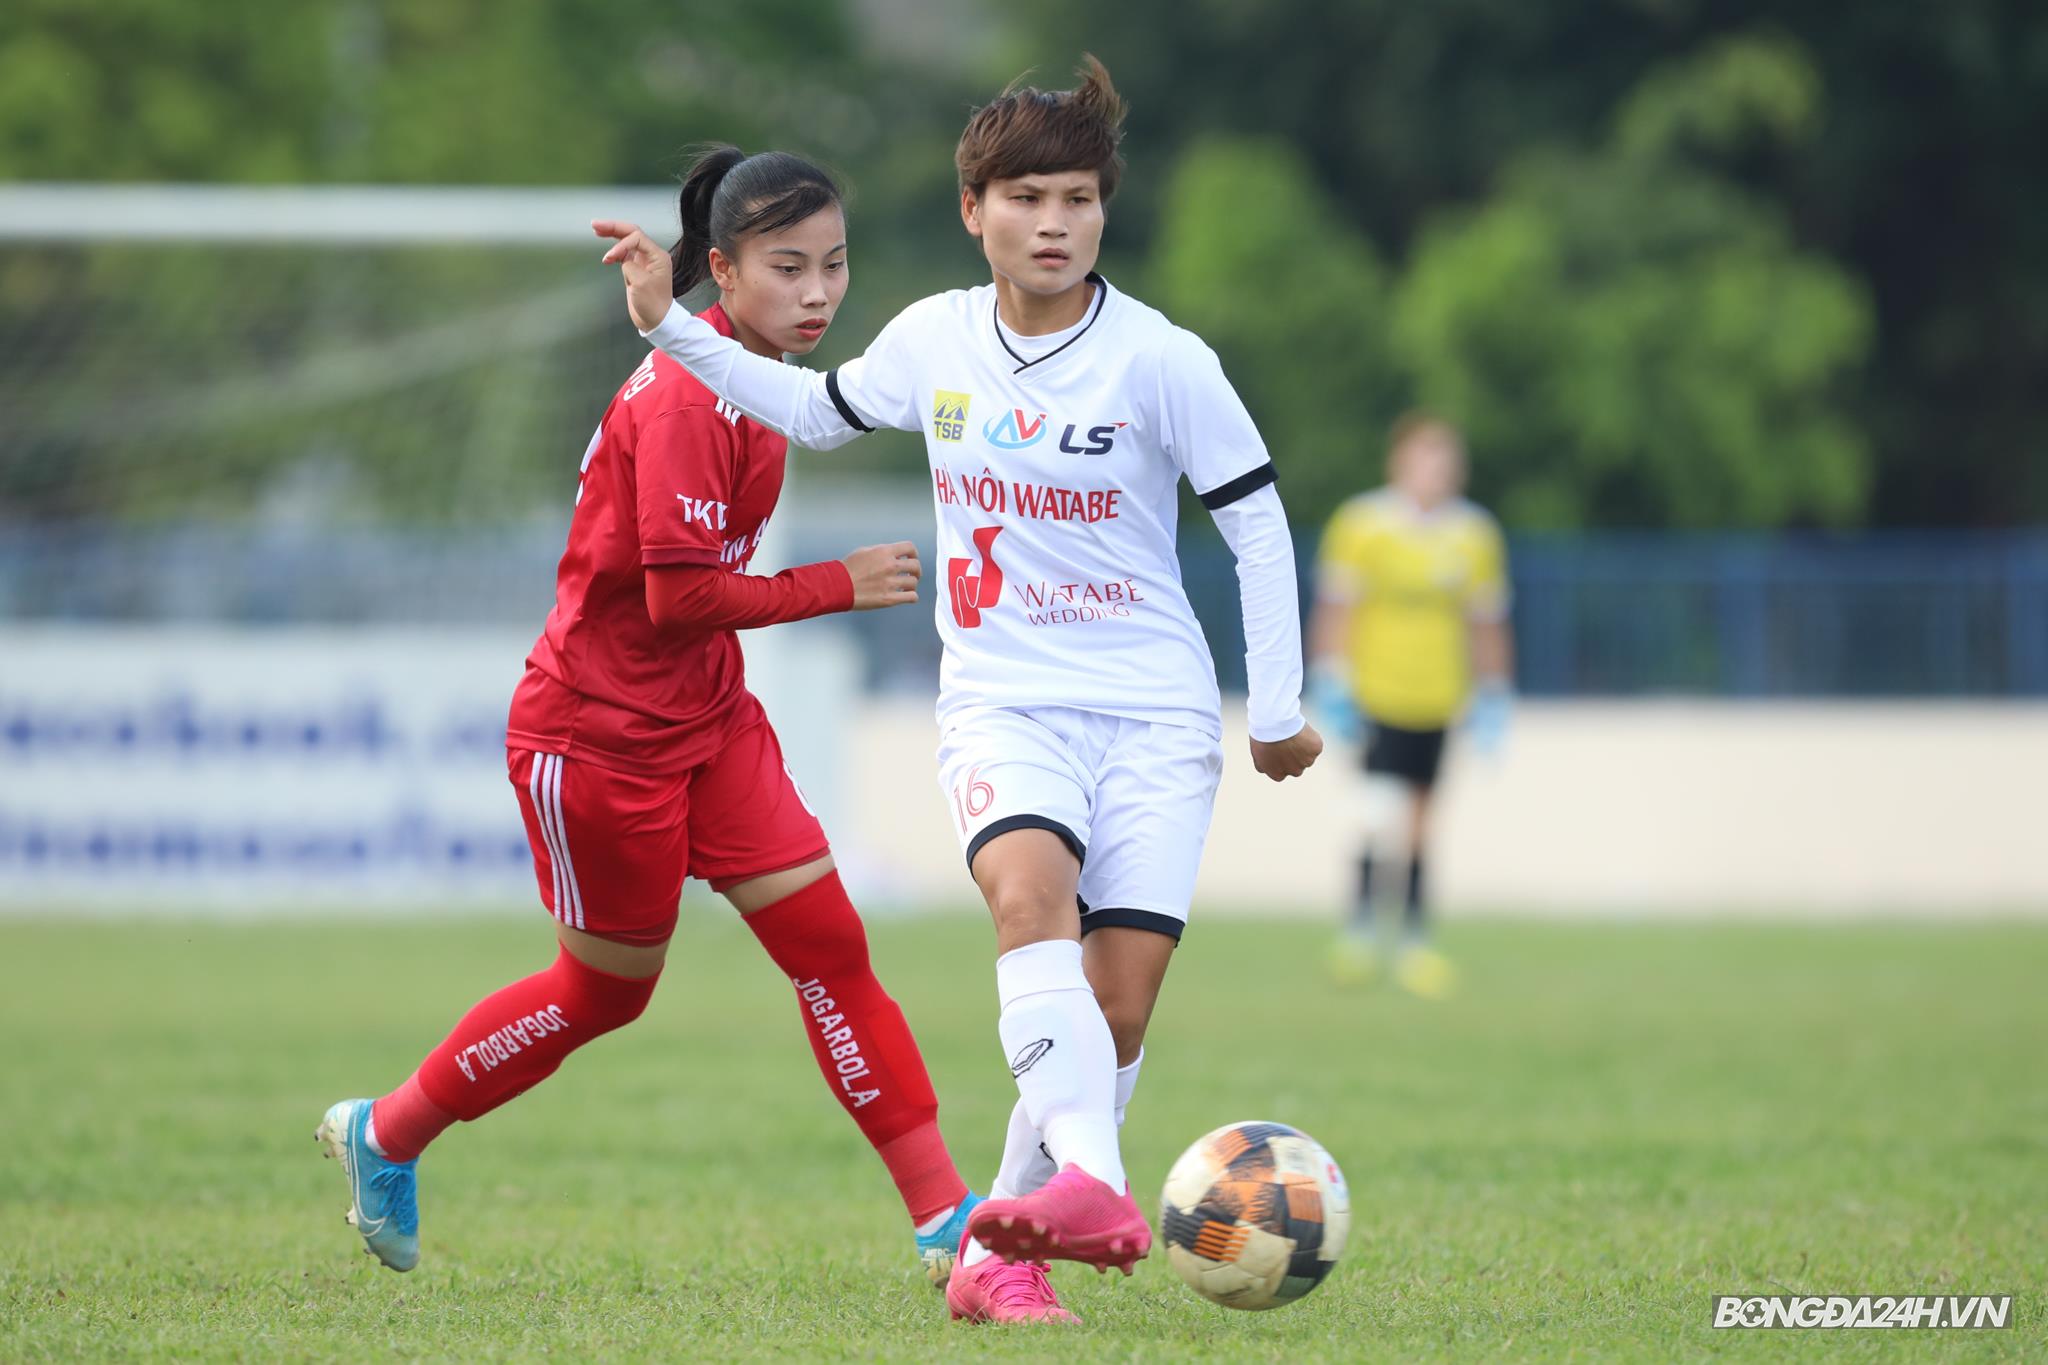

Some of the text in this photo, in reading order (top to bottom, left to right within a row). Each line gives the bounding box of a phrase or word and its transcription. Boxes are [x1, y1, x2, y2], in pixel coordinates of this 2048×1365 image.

[934, 420, 964, 440] TSB
[1059, 423, 1119, 455] LS
[1014, 483, 1122, 523] WATABE
[1014, 578, 1144, 608] WATABE
[1029, 602, 1131, 626] WEDDING
[954, 768, 995, 834] 16
[455, 1003, 570, 1082] JOGARBOLA
[793, 977, 880, 1109] JOGARBOLA
